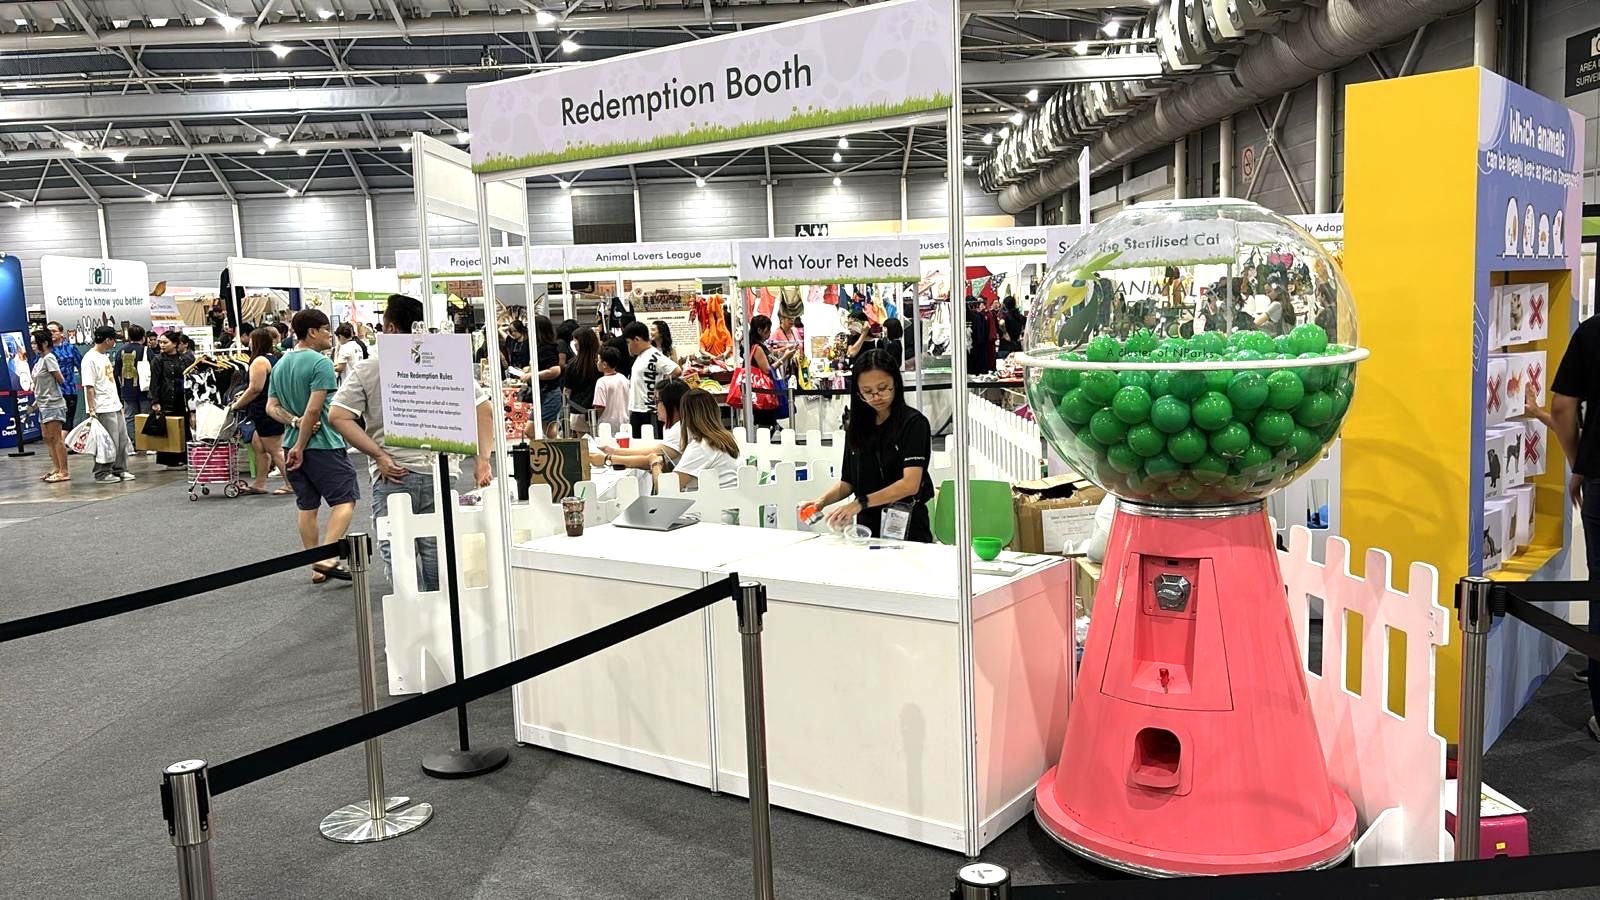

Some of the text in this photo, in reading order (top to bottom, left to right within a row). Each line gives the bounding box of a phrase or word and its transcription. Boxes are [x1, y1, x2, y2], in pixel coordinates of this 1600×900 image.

[1580, 60, 1597, 74] AREA
[562, 54, 812, 126] Redemption Booth
[1510, 106, 1564, 158] Which animals
[1486, 150, 1498, 169] can
[1498, 152, 1506, 170] be
[1507, 153, 1524, 178] legally
[1524, 158, 1535, 182] kept
[1536, 164, 1542, 180] as
[1542, 164, 1552, 184] pets
[1316, 222, 1344, 234] Adop
[964, 238, 1003, 248] Animals
[1124, 234, 1188, 250] Sterilised
[1194, 232, 1220, 246] Cat
[596, 250, 702, 261] Animal Lovers League
[752, 252, 909, 270] What Your Pet Needs
[89, 262, 112, 285] rein
[1114, 280, 1198, 297] ANIMAL
[57, 296, 143, 308] Getting to know you better
[1106, 349, 1114, 357] A
[1158, 348, 1168, 357] of
[1173, 349, 1214, 358] NParks
[410, 372, 438, 380] Redemption
